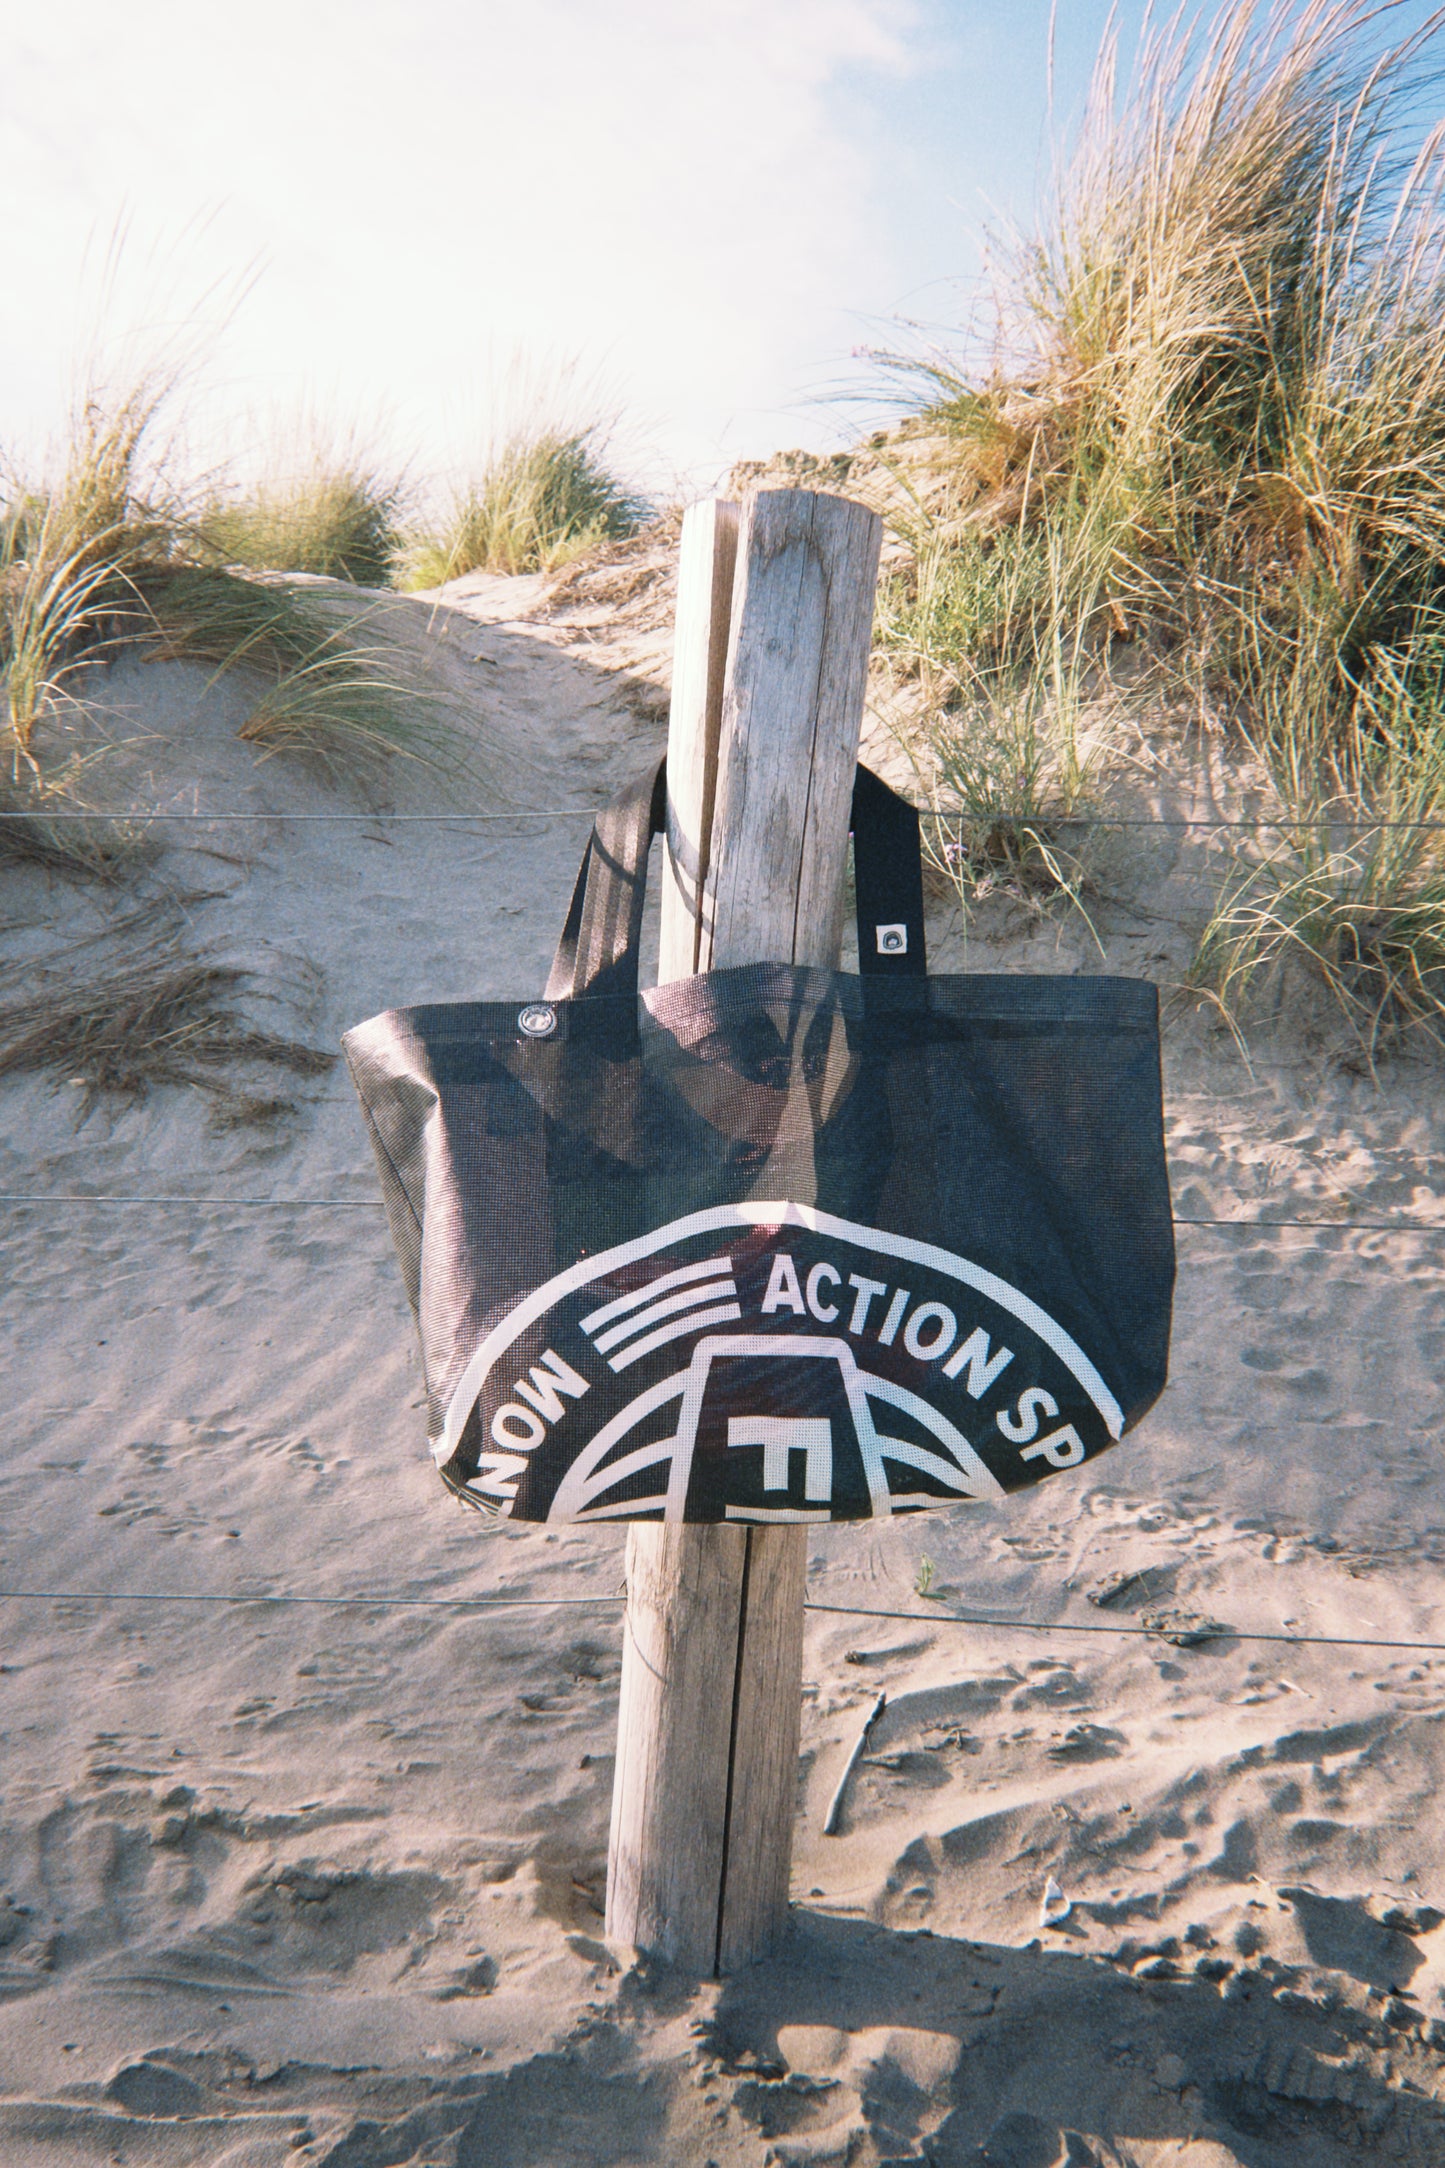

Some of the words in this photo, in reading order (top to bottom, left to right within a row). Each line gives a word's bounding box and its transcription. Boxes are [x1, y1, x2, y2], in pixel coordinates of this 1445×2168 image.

[465, 1348, 592, 1519] NOW
[760, 1253, 1016, 1401] ACTION
[995, 1386, 1086, 1469] SP
